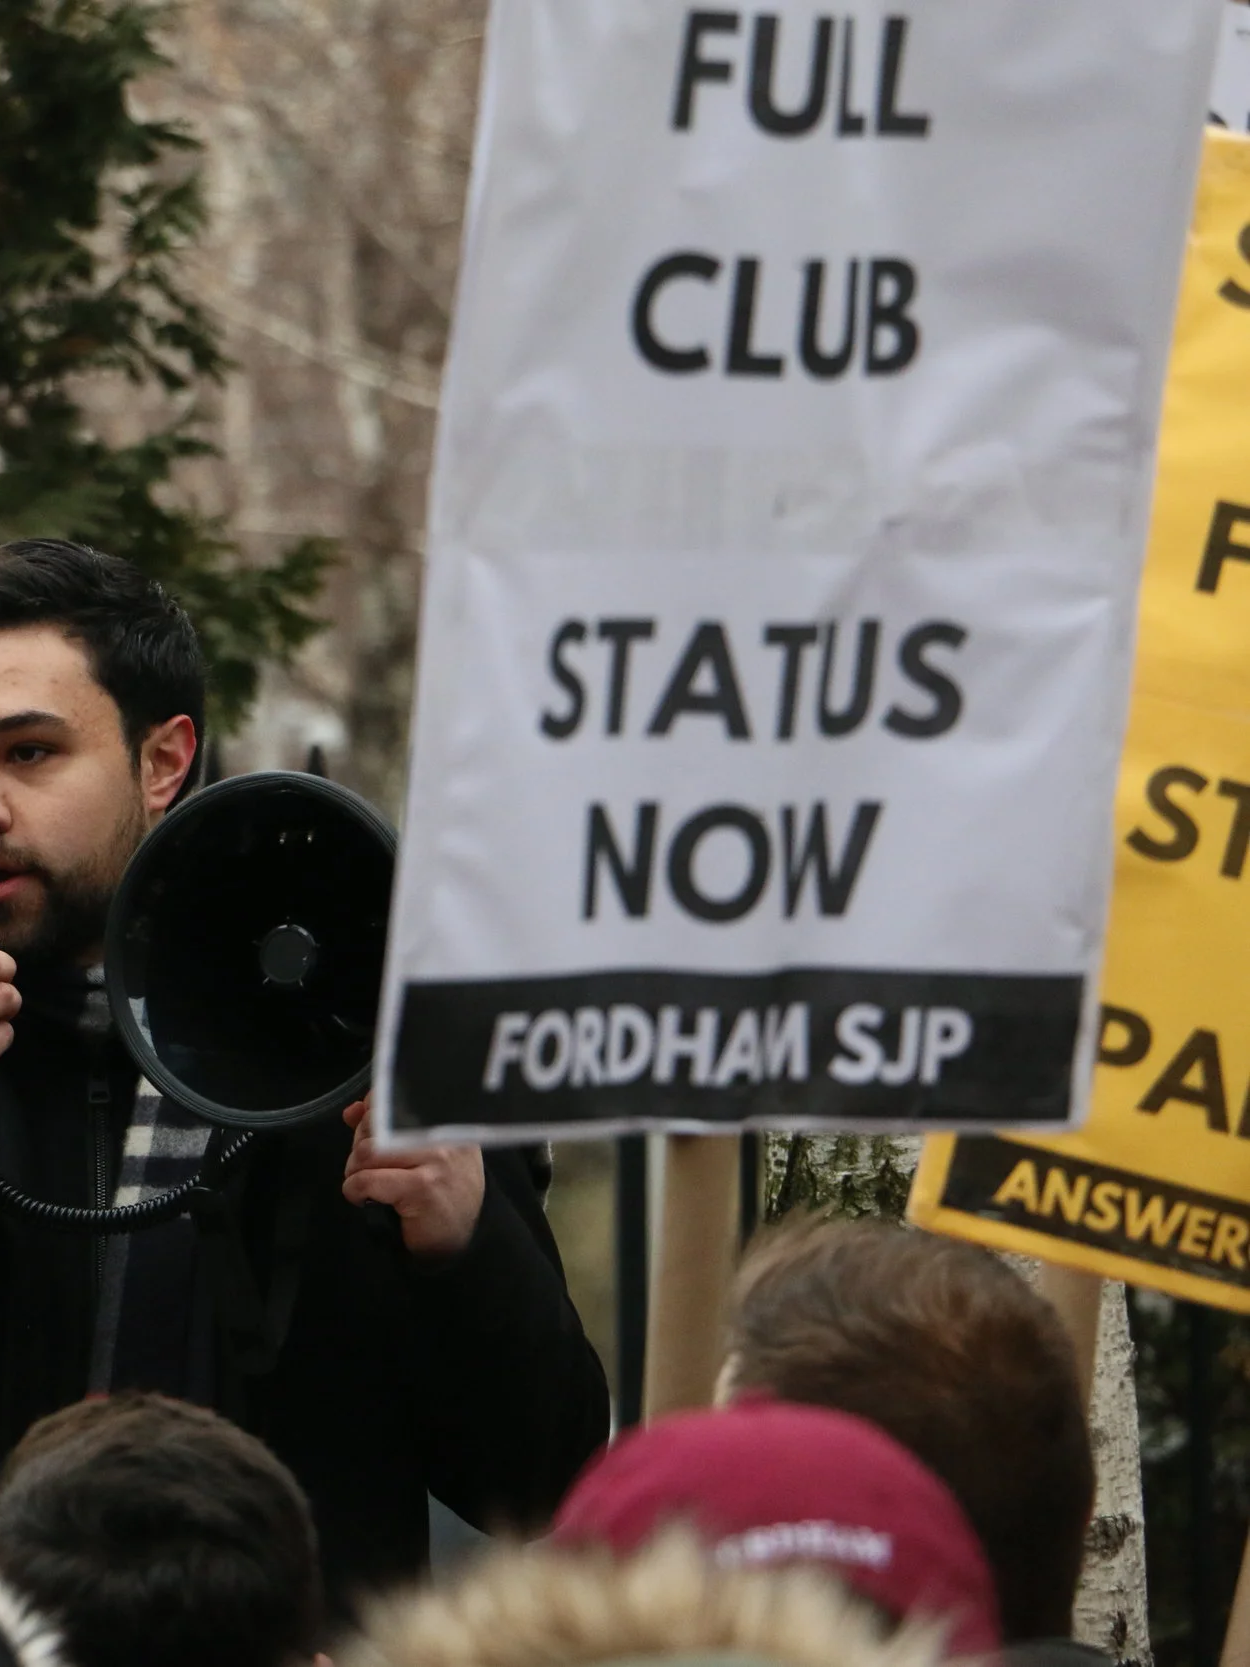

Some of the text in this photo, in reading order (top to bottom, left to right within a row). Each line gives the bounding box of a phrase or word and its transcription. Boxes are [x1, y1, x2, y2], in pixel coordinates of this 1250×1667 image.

[669, 10, 931, 138] FULL
[629, 248, 921, 381] CLUB
[540, 618, 967, 743] STATUS
[582, 801, 881, 924] NOW
[482, 1003, 972, 1092] FORDHAM SJP
[1096, 1001, 1250, 1141] PA
[991, 1158, 1250, 1270] ANSWER
